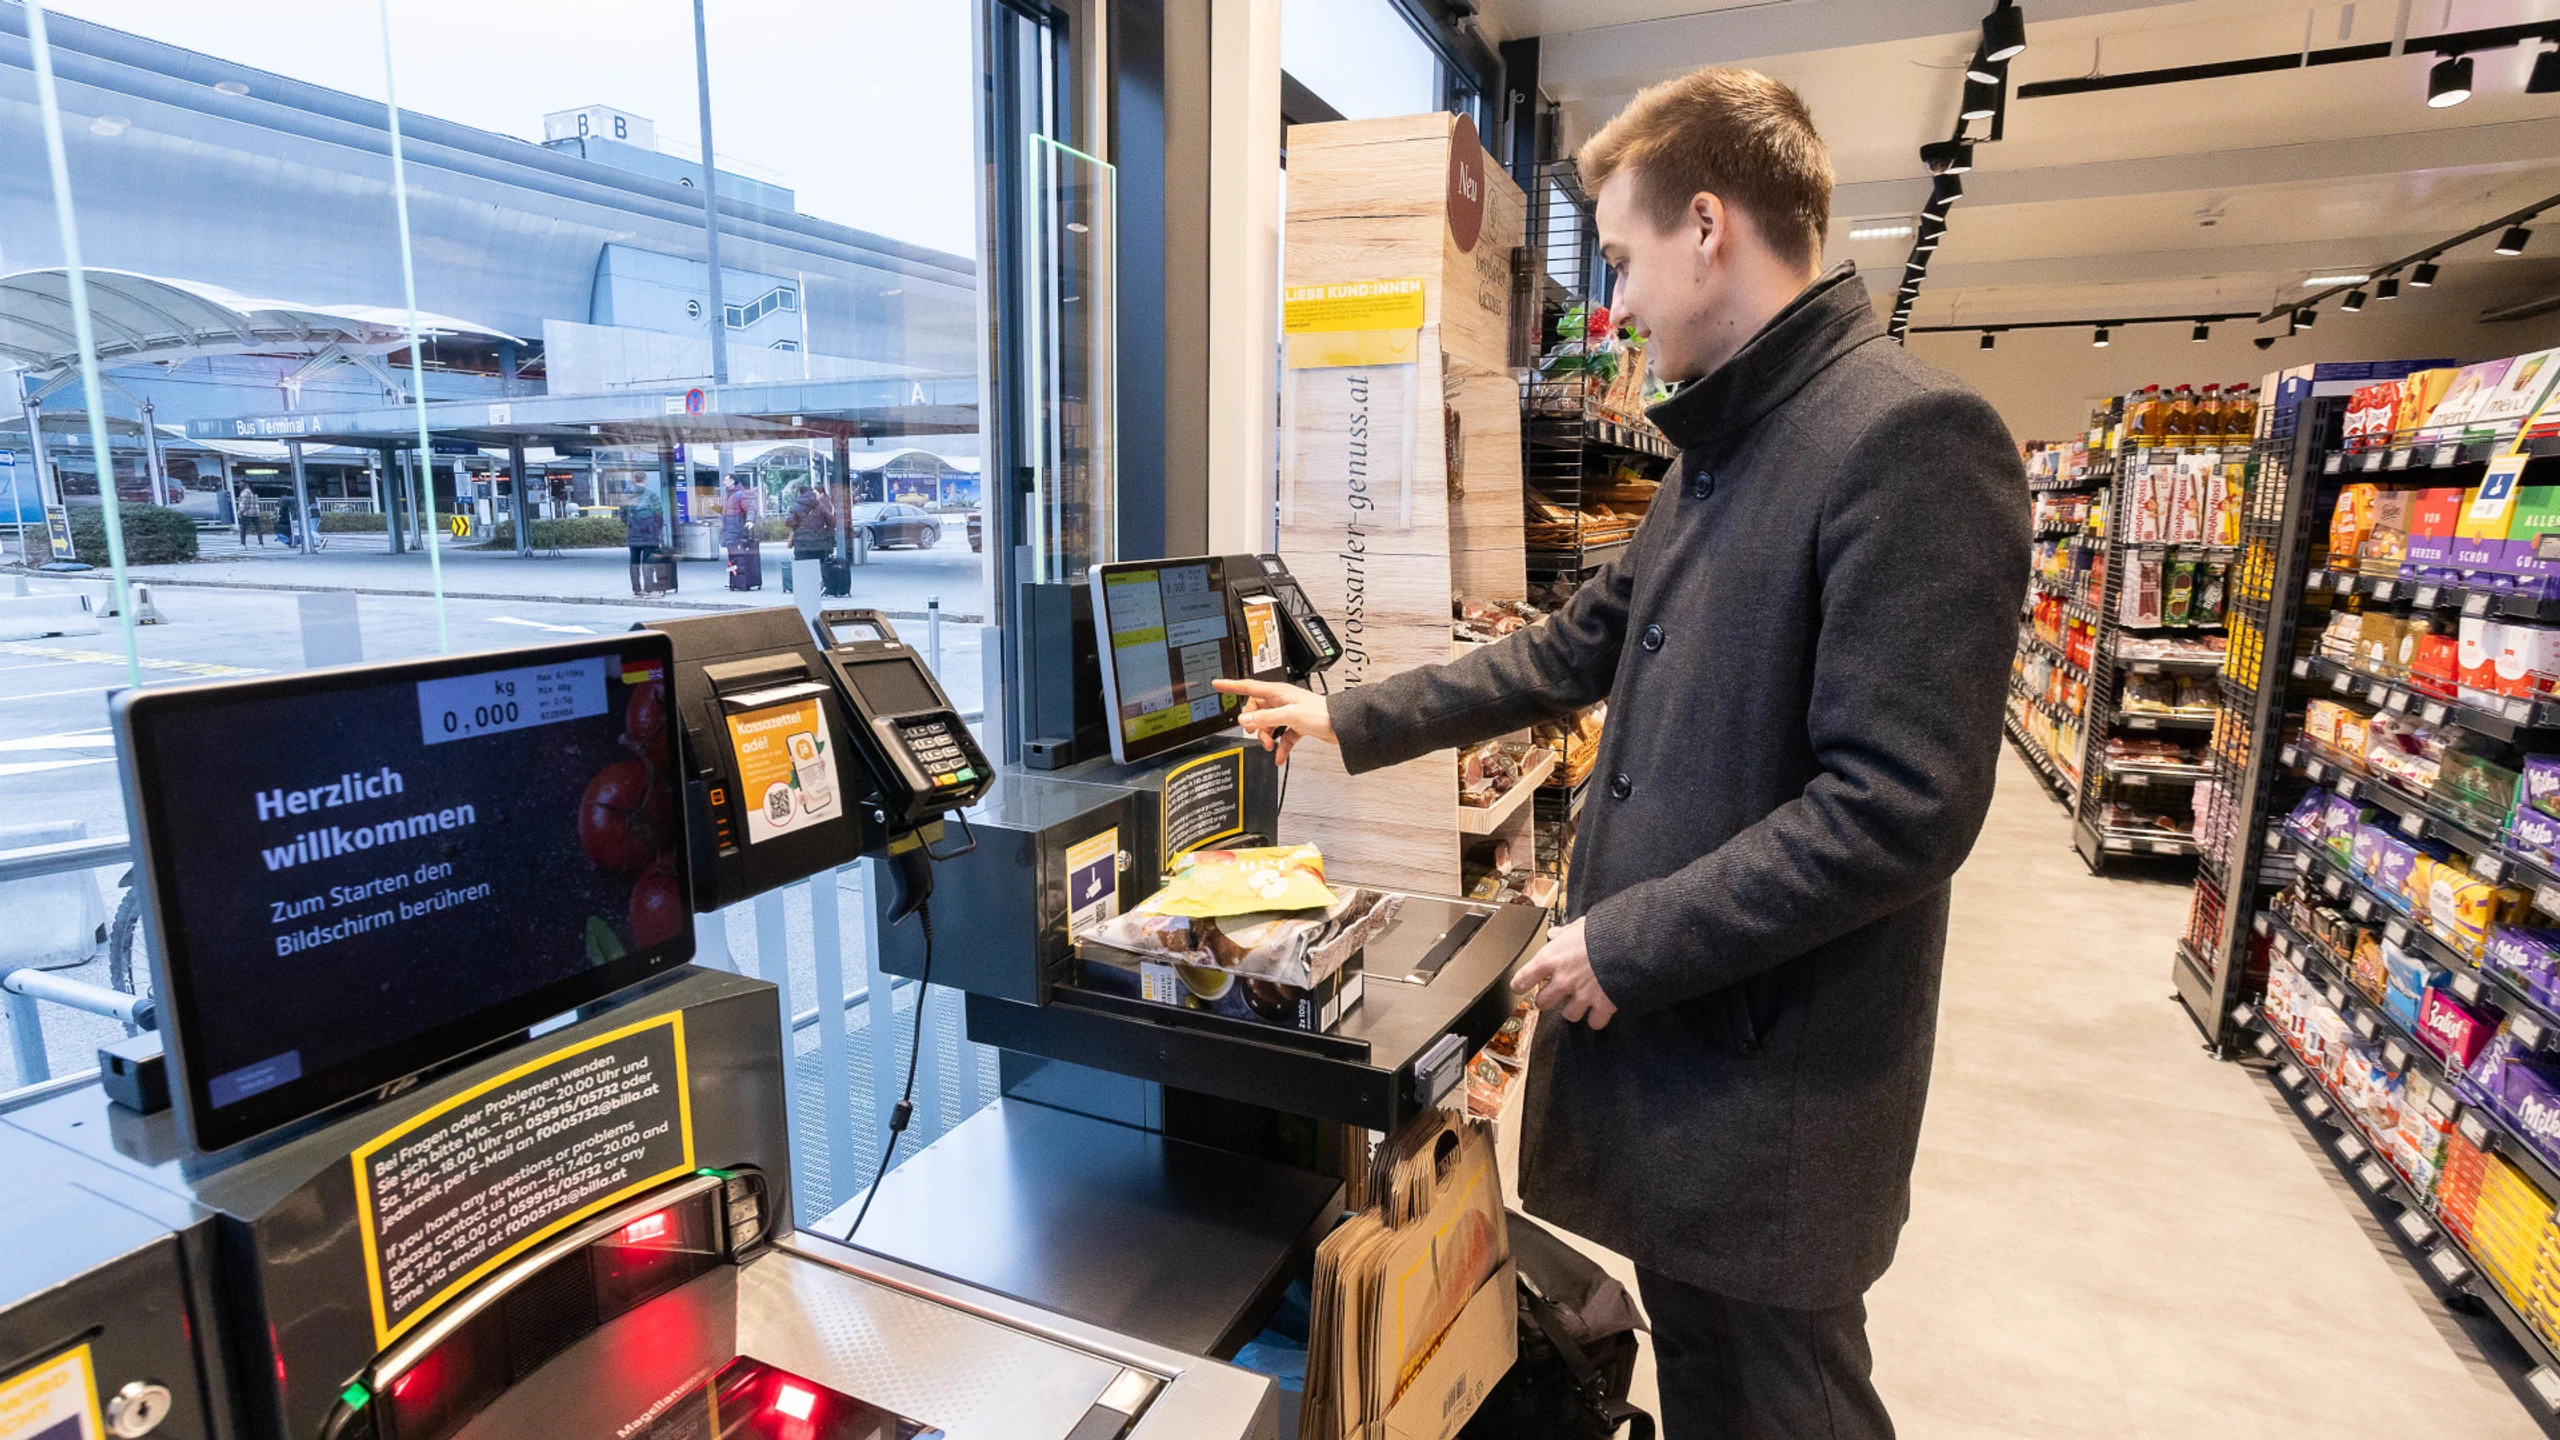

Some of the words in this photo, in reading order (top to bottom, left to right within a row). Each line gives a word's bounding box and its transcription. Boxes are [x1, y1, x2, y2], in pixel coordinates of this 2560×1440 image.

[578, 113, 589, 136] B
[614, 115, 627, 140] B
[1458, 161, 1477, 203] Neu
[1285, 288, 1324, 302] LIEBE
[1328, 280, 1420, 299] KUND:INNEN
[911, 382, 926, 405] A
[2489, 389, 2535, 413] merci
[235, 419, 256, 436] Bus
[258, 417, 305, 435] Terminal
[312, 417, 322, 432] A
[2424, 513, 2441, 523] VON
[2411, 547, 2442, 560] HERZEN
[2458, 549, 2489, 563] SCHÖN
[495, 681, 515, 697] kg
[443, 702, 519, 733] 0,000
[737, 711, 802, 735] Kassazettel
[742, 736, 768, 753] adé!
[256, 767, 404, 822] Herzlich
[262, 800, 476, 871] willkommen
[270, 893, 325, 923] Zum
[330, 871, 409, 908] Starten
[414, 860, 453, 883] den
[276, 907, 395, 958] Bildschirm
[399, 880, 491, 921] berühren
[374, 1154, 398, 1177] Bei
[399, 1128, 448, 1167] Fragen
[450, 1111, 483, 1135] oder
[485, 1078, 559, 1117] Problemen
[561, 1055, 615, 1082] wenden
[377, 1176, 398, 1195] Sie
[400, 1155, 428, 1185] sich
[430, 1140, 463, 1172] bitte
[596, 1065, 620, 1083] Uhr
[622, 1056, 649, 1075] und
[379, 1195, 401, 1213] Sa.
[478, 1134, 503, 1156] Uhr
[505, 1124, 523, 1140] an
[525, 1083, 619, 1130] 059915/05732
[621, 1072, 652, 1090] oder
[381, 1184, 442, 1235] jederzeit
[443, 1170, 466, 1196] per
[469, 1147, 514, 1176] E-Mail
[516, 1137, 535, 1154] an
[536, 1083, 659, 1142] f0005732@billa.at
[388, 1242, 433, 1282] please
[435, 1209, 488, 1245] contact
[490, 1198, 506, 1213] us
[642, 1121, 669, 1140] and
[398, 1232, 424, 1257] you
[425, 1209, 460, 1235] have
[461, 1190, 486, 1214] any
[489, 1156, 553, 1201] questions
[555, 1149, 570, 1162] or
[572, 1120, 635, 1159] problems
[390, 1275, 415, 1296] Sat
[489, 1214, 507, 1228] on
[509, 1167, 602, 1217] 059915/05732
[603, 1157, 617, 1169] or
[620, 1146, 645, 1168] any
[392, 1284, 424, 1312] time
[426, 1266, 446, 1287] via
[448, 1240, 486, 1272] email
[487, 1232, 504, 1246] at
[505, 1168, 628, 1236] f0005732@billa.at
[616, 1389, 680, 1439] Magellan
